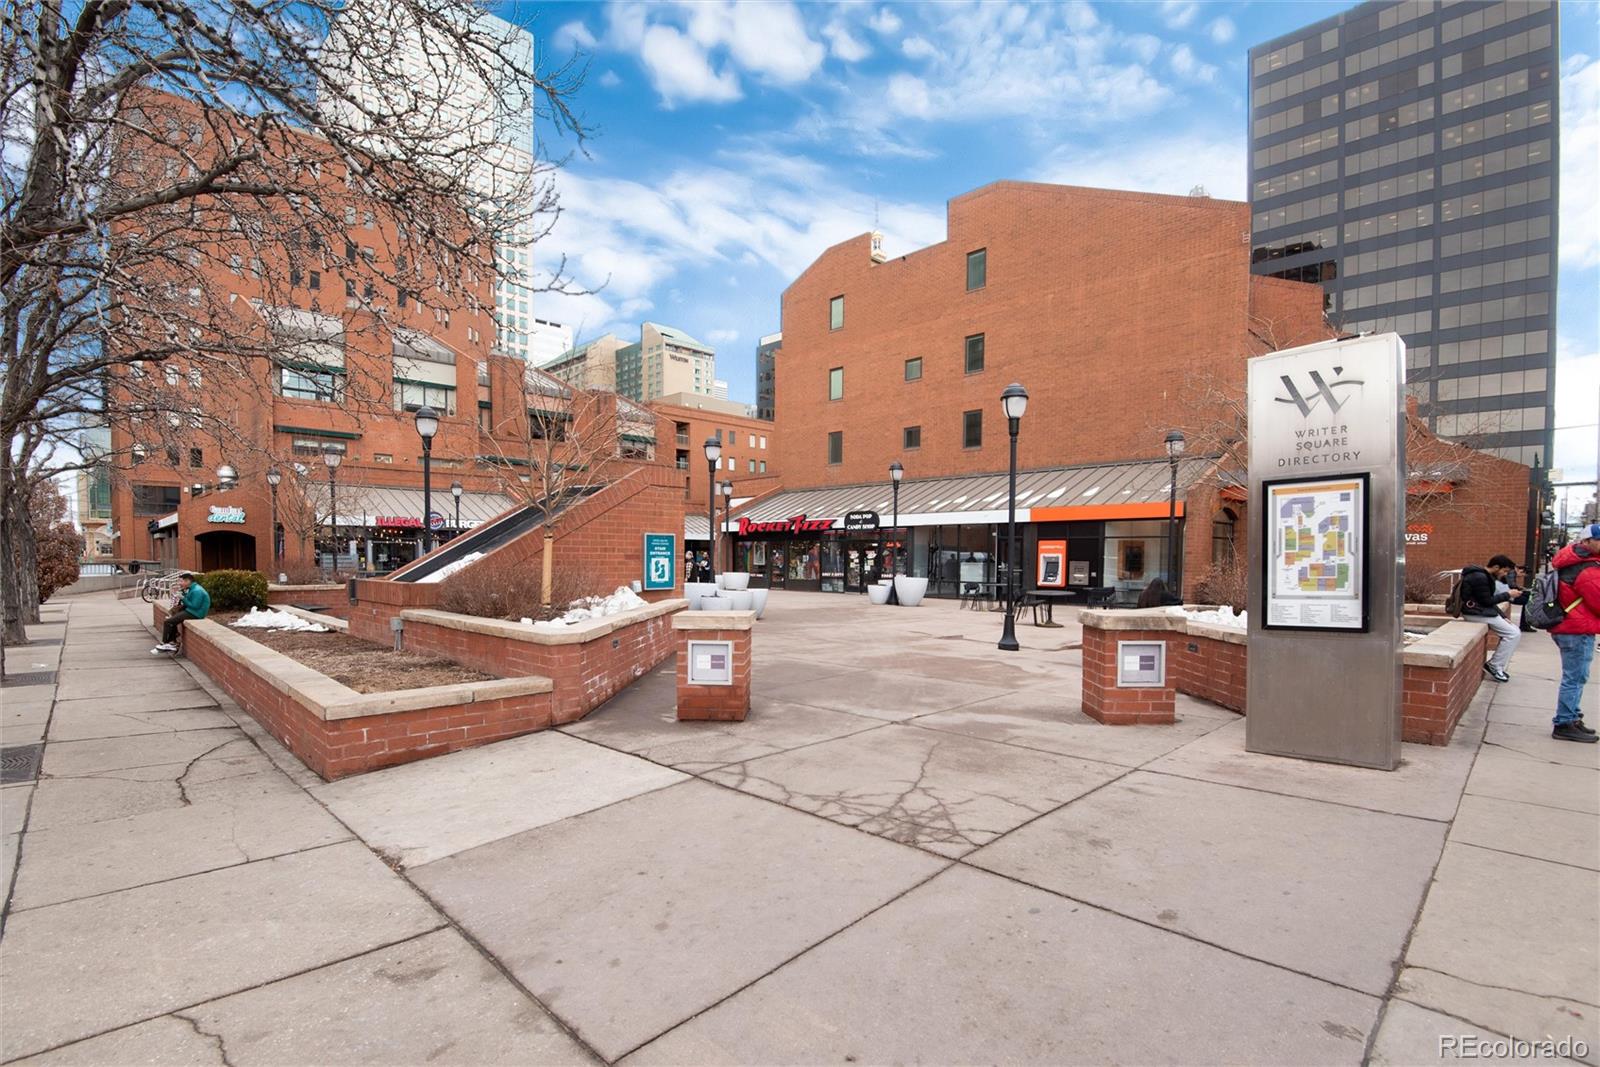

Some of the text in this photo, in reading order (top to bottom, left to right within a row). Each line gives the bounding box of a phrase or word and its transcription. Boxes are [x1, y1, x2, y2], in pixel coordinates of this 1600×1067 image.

[1295, 425, 1348, 438] WRITER
[1296, 437, 1348, 451] SQUARE
[1278, 451, 1361, 467] DIRECTORY
[376, 515, 426, 528] ILLEGAL
